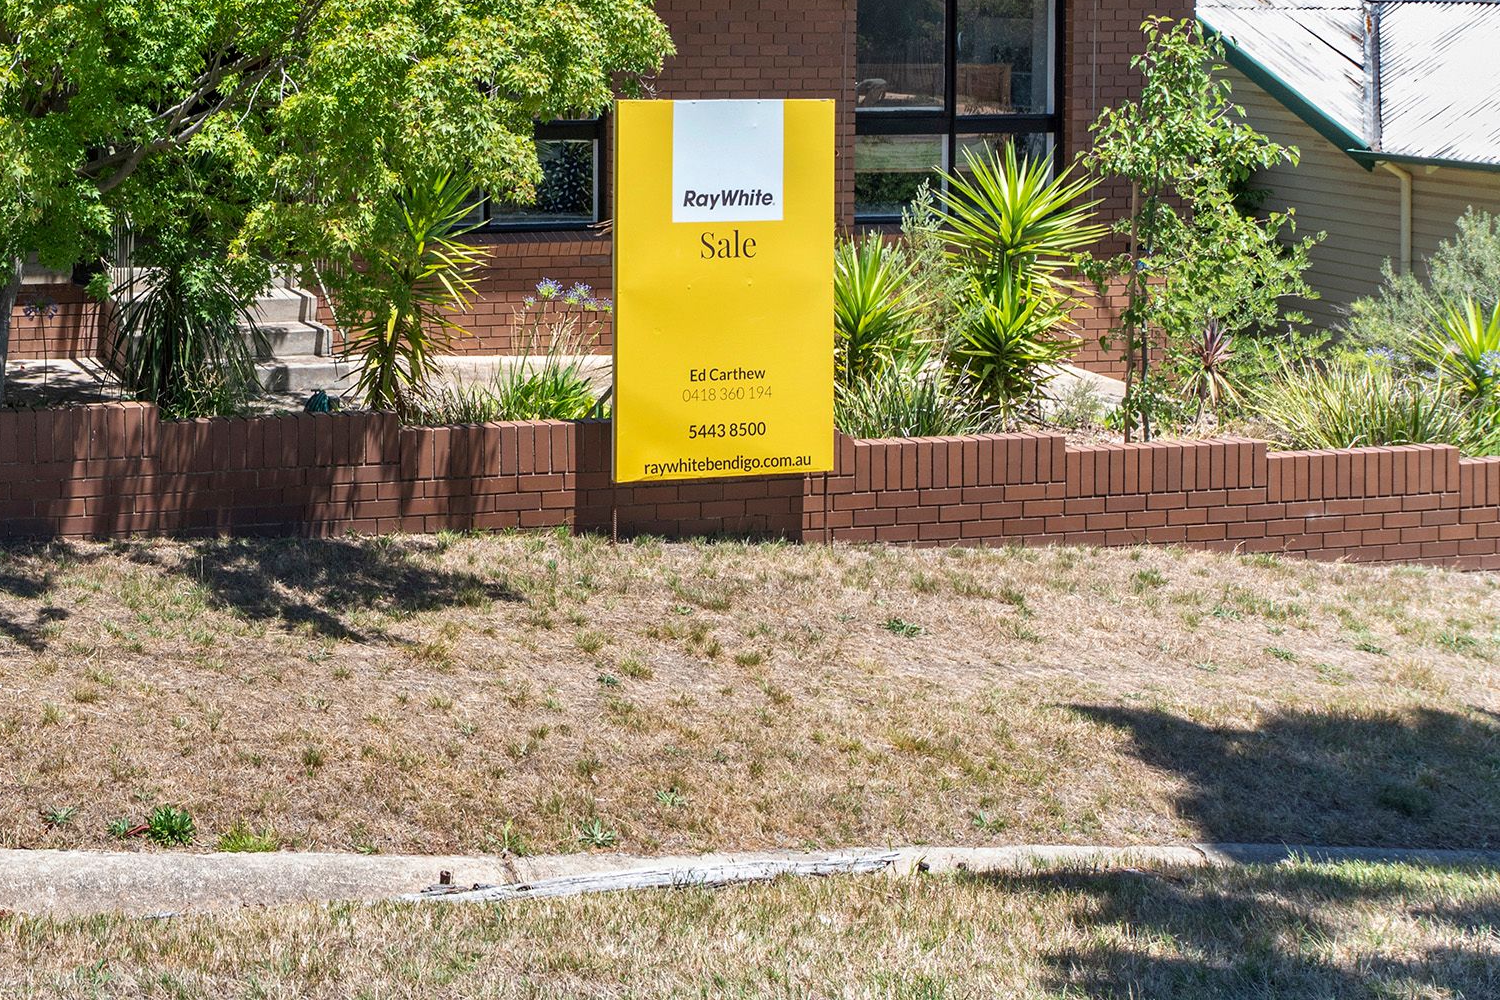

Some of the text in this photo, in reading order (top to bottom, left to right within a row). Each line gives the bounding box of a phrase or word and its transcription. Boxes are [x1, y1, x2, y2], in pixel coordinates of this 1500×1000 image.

[700, 229, 757, 260] Sale
[689, 367, 766, 382] Ed Carthew
[682, 385, 773, 403] 0418 360 194
[688, 421, 767, 439] 5443 8500
[644, 455, 812, 476] raywhitebendigo.com.au
